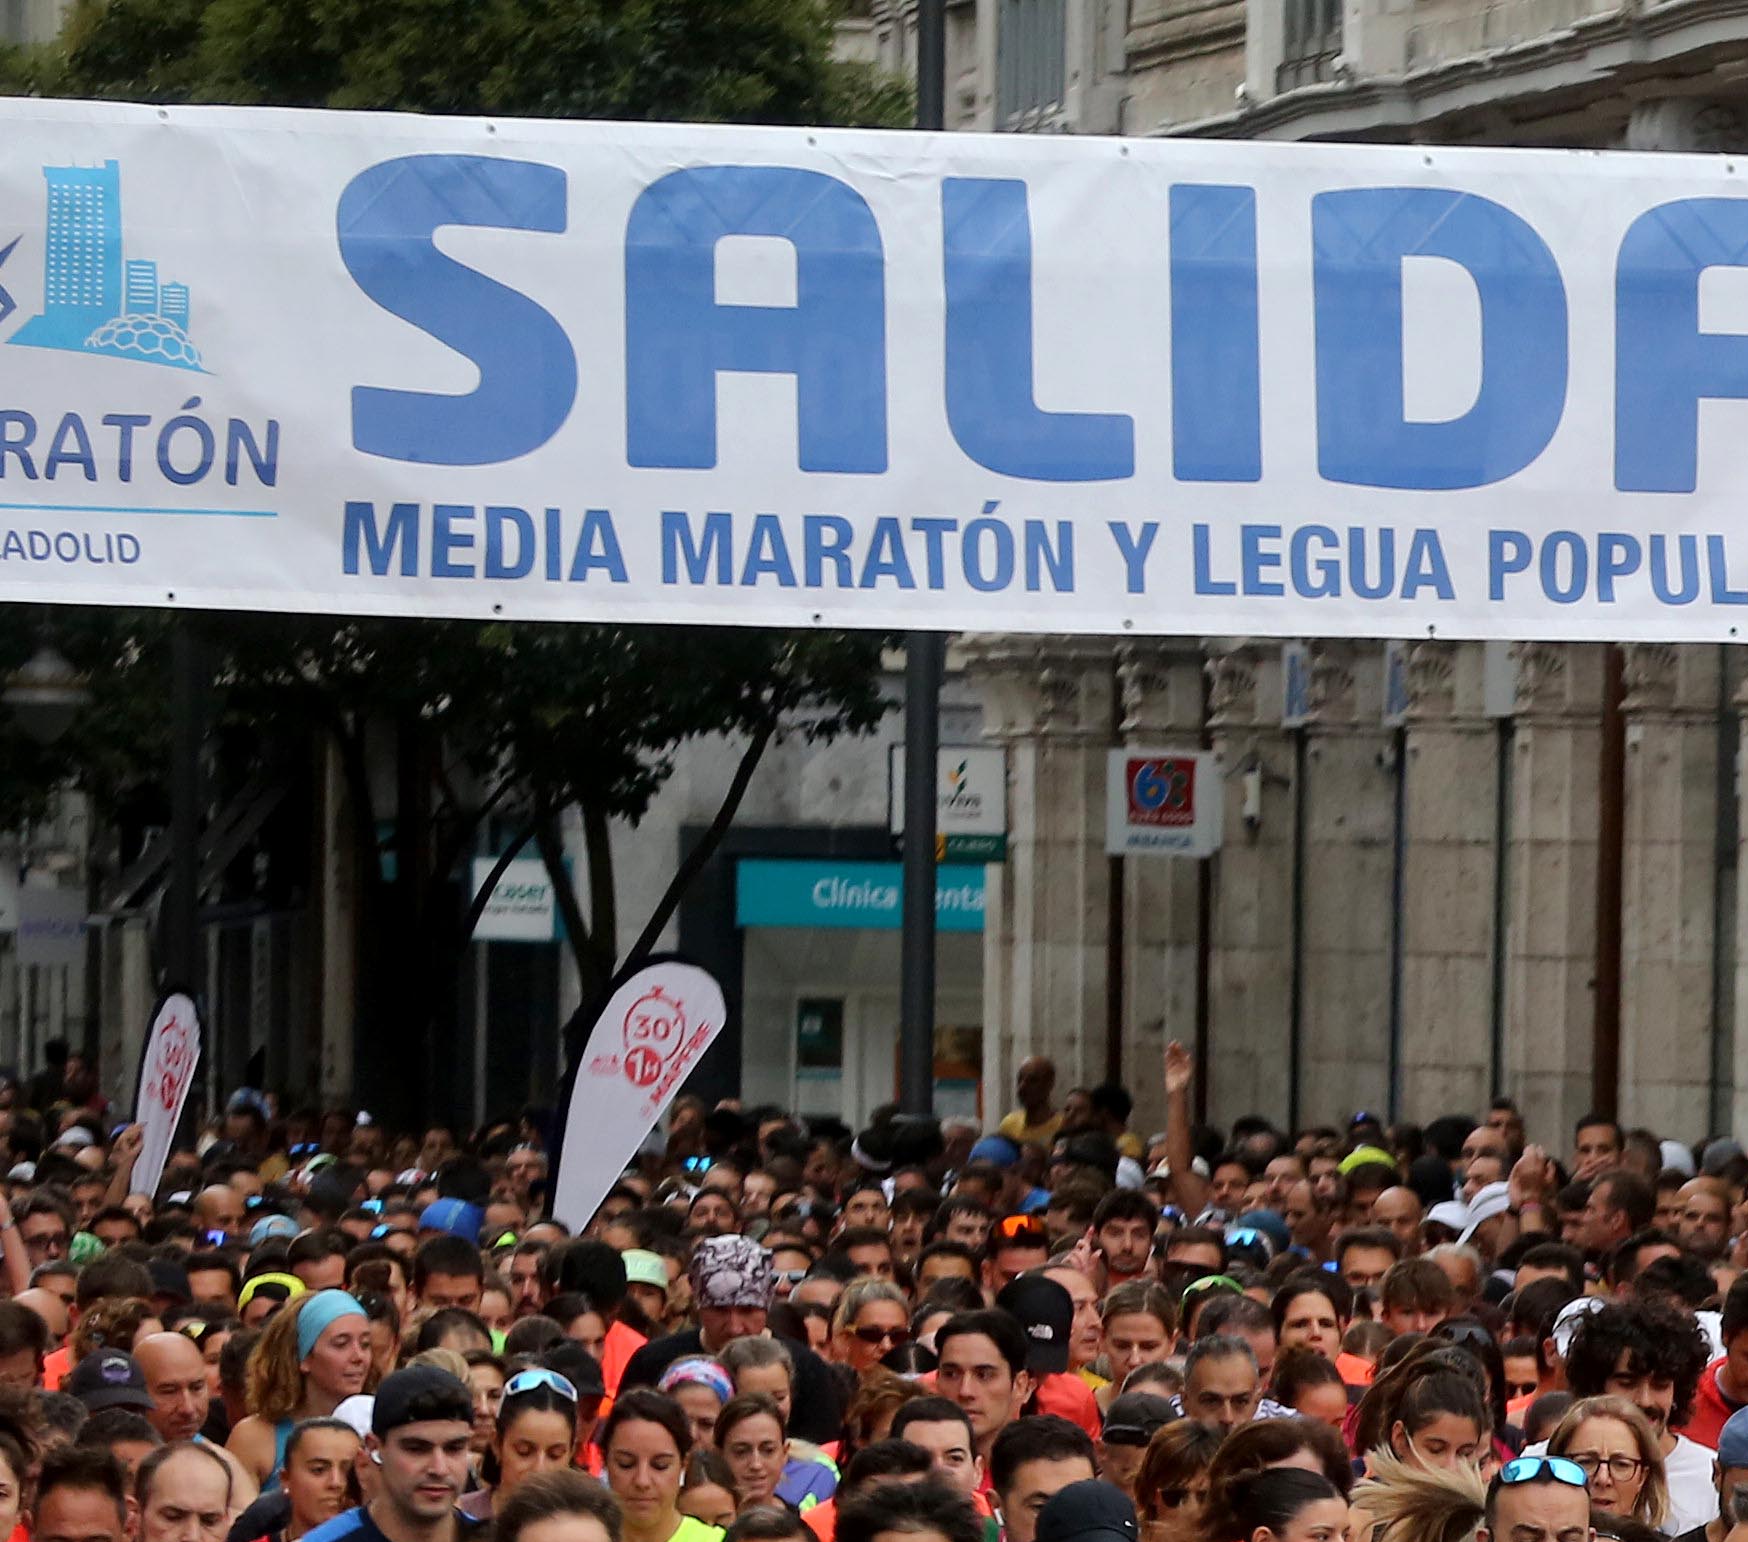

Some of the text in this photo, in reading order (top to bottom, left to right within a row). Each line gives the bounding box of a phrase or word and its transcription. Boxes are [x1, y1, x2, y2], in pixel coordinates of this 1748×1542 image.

[0, 530, 141, 564] ADOLID
[342, 500, 628, 583] MEDIA
[662, 500, 1075, 592] MARATÓN
[1108, 520, 1159, 595] Y
[1192, 522, 1456, 600] LEGUA
[812, 876, 899, 910] Clínica
